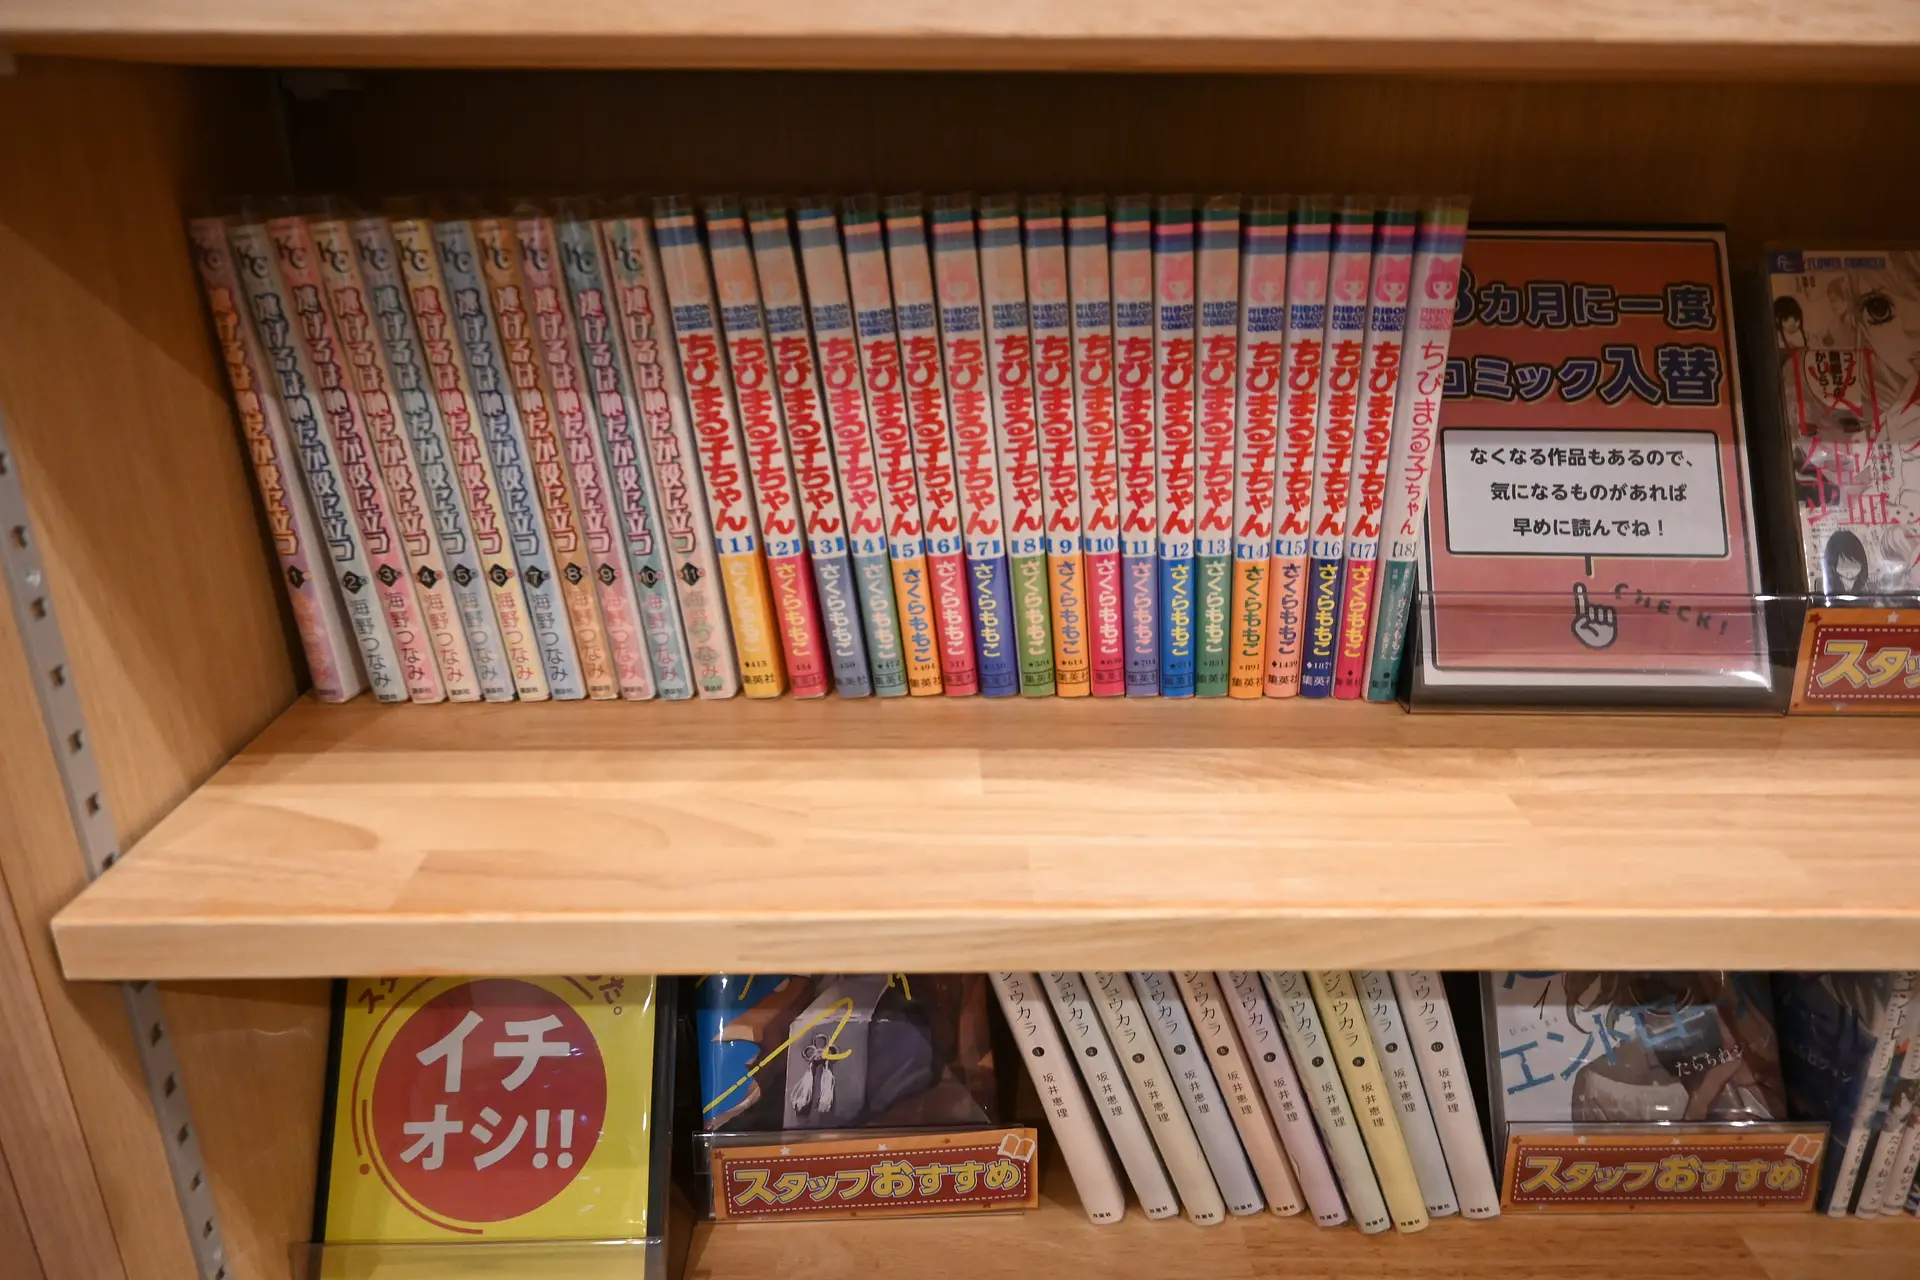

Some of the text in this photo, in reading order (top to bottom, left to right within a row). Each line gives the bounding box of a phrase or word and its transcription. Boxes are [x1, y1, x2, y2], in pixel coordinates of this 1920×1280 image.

[680, 335, 748, 532] ちびまる子ちゃん
[730, 338, 796, 535] ちびまる子ちゃん
[773, 337, 840, 534] ちびまる子ちゃん
[820, 338, 882, 534] ちびまる子ちゃん
[863, 341, 921, 536] ちびまる子ちゃん
[903, 336, 958, 532] ちびまる子ちゃん
[946, 339, 999, 534] ちびまる子ちゃん
[995, 335, 1044, 532] ちびまる子ちゃん
[1035, 335, 1080, 532] ちびまる子ちゃん
[1078, 334, 1119, 531] ちびまる子ちゃん
[1117, 336, 1156, 532] ちびまる子ちゃん
[1160, 338, 1195, 534] ちびまる子ちゃん
[1200, 334, 1232, 531] ちびまる子ちゃん
[1239, 340, 1281, 537] ちびまる子ちゃん
[1279, 339, 1321, 535] ちびまる子ちゃん
[1316, 340, 1361, 536] ちびまる子ちゃん
[1352, 341, 1399, 536] ちびまる子ちゃん
[1400, 341, 1445, 535] ちびまる子ちゃん
[1470, 447, 1693, 467] なくなる作品もあるので、
[1490, 482, 1687, 501] 気になるものがあれば
[1513, 517, 1664, 538] 早めに読んでね！
[776, 564, 810, 656] さくらももこ
[820, 564, 853, 656] さくらももこ
[863, 564, 896, 658] さくらももこ
[903, 568, 931, 662] さくらももこ
[936, 561, 965, 655] さくらももこ
[974, 563, 1000, 657] さくらももこ
[1021, 561, 1046, 655] さくらももこ
[1057, 561, 1080, 655] さくらももこ
[1096, 559, 1118, 654] さくらももこ
[1131, 562, 1152, 654] さくらももこ
[1170, 564, 1190, 656] さくらももこ
[1205, 561, 1225, 653] さくらももこ
[1242, 566, 1264, 657] さくらももこ
[1278, 563, 1301, 655] さくらももこ
[1313, 564, 1339, 656] さくらももこ
[1344, 564, 1371, 658] さくらももこ
[416, 1010, 570, 1092] イチ
[400, 1104, 575, 1171] オシ!!
[732, 1159, 1022, 1205] スタッフおすすめ
[1520, 1155, 1803, 1194] スタッフおすすめ
